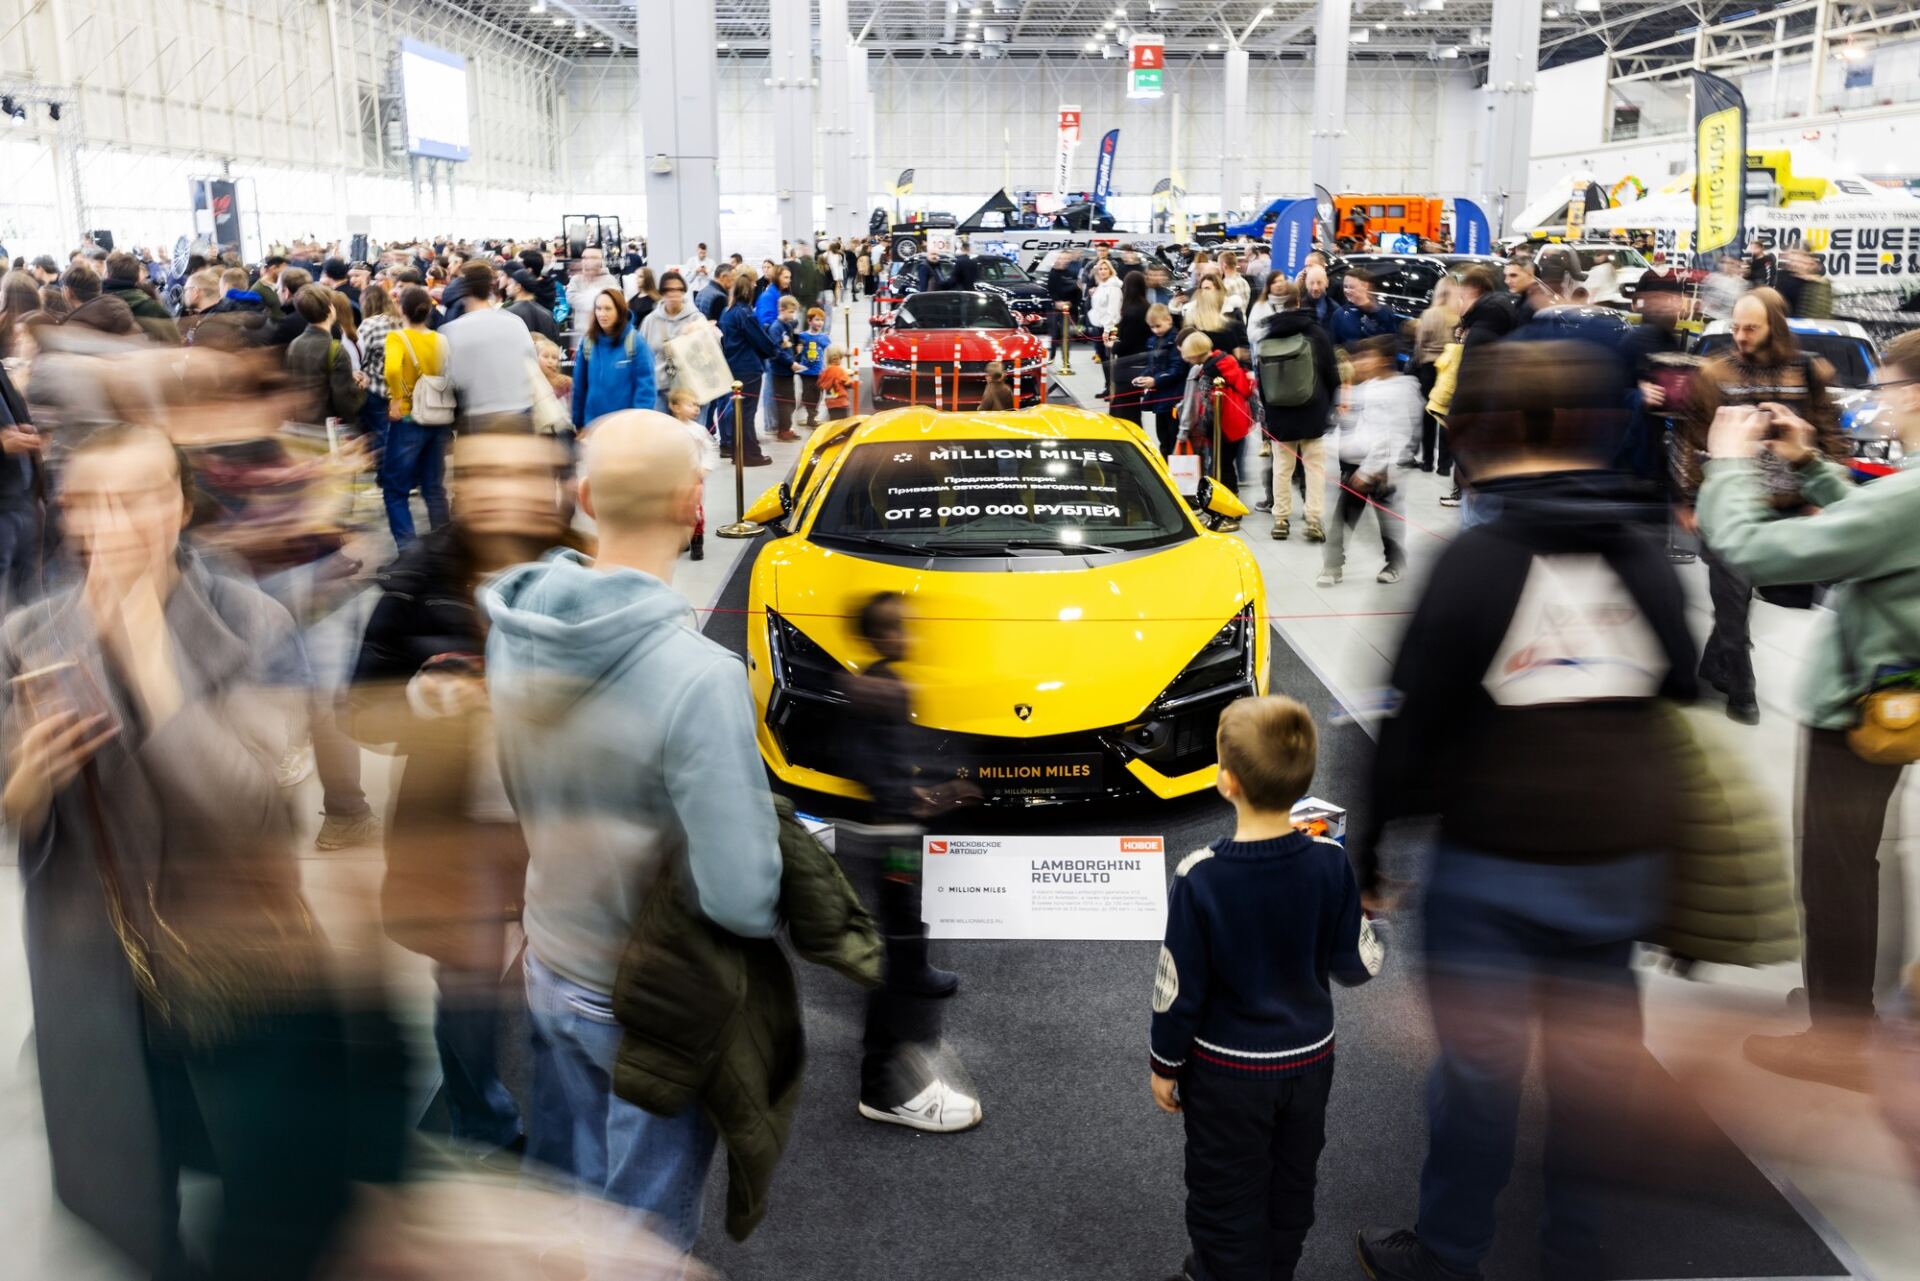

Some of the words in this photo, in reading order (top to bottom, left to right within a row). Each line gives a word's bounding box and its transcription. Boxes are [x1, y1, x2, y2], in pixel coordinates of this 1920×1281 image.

[930, 449, 1032, 461] MILLION
[1039, 450, 1114, 462] MILES
[944, 476, 1020, 484] Предлагаем
[952, 482, 1028, 491] автомобили
[885, 509, 914, 520] ОТ
[920, 508, 932, 518] 2
[937, 506, 981, 517] 000
[986, 505, 1029, 516] 000
[1034, 504, 1121, 518] РУБЛЕЙ
[979, 766, 1041, 779] MILLION
[1046, 765, 1091, 777] MILES
[1123, 841, 1158, 850] НОВОЕ
[1031, 859, 1141, 871] LAMBORGHINI
[1031, 872, 1110, 884] REVUELTO
[948, 886, 981, 894] MILLION
[983, 886, 1007, 894] MILES
